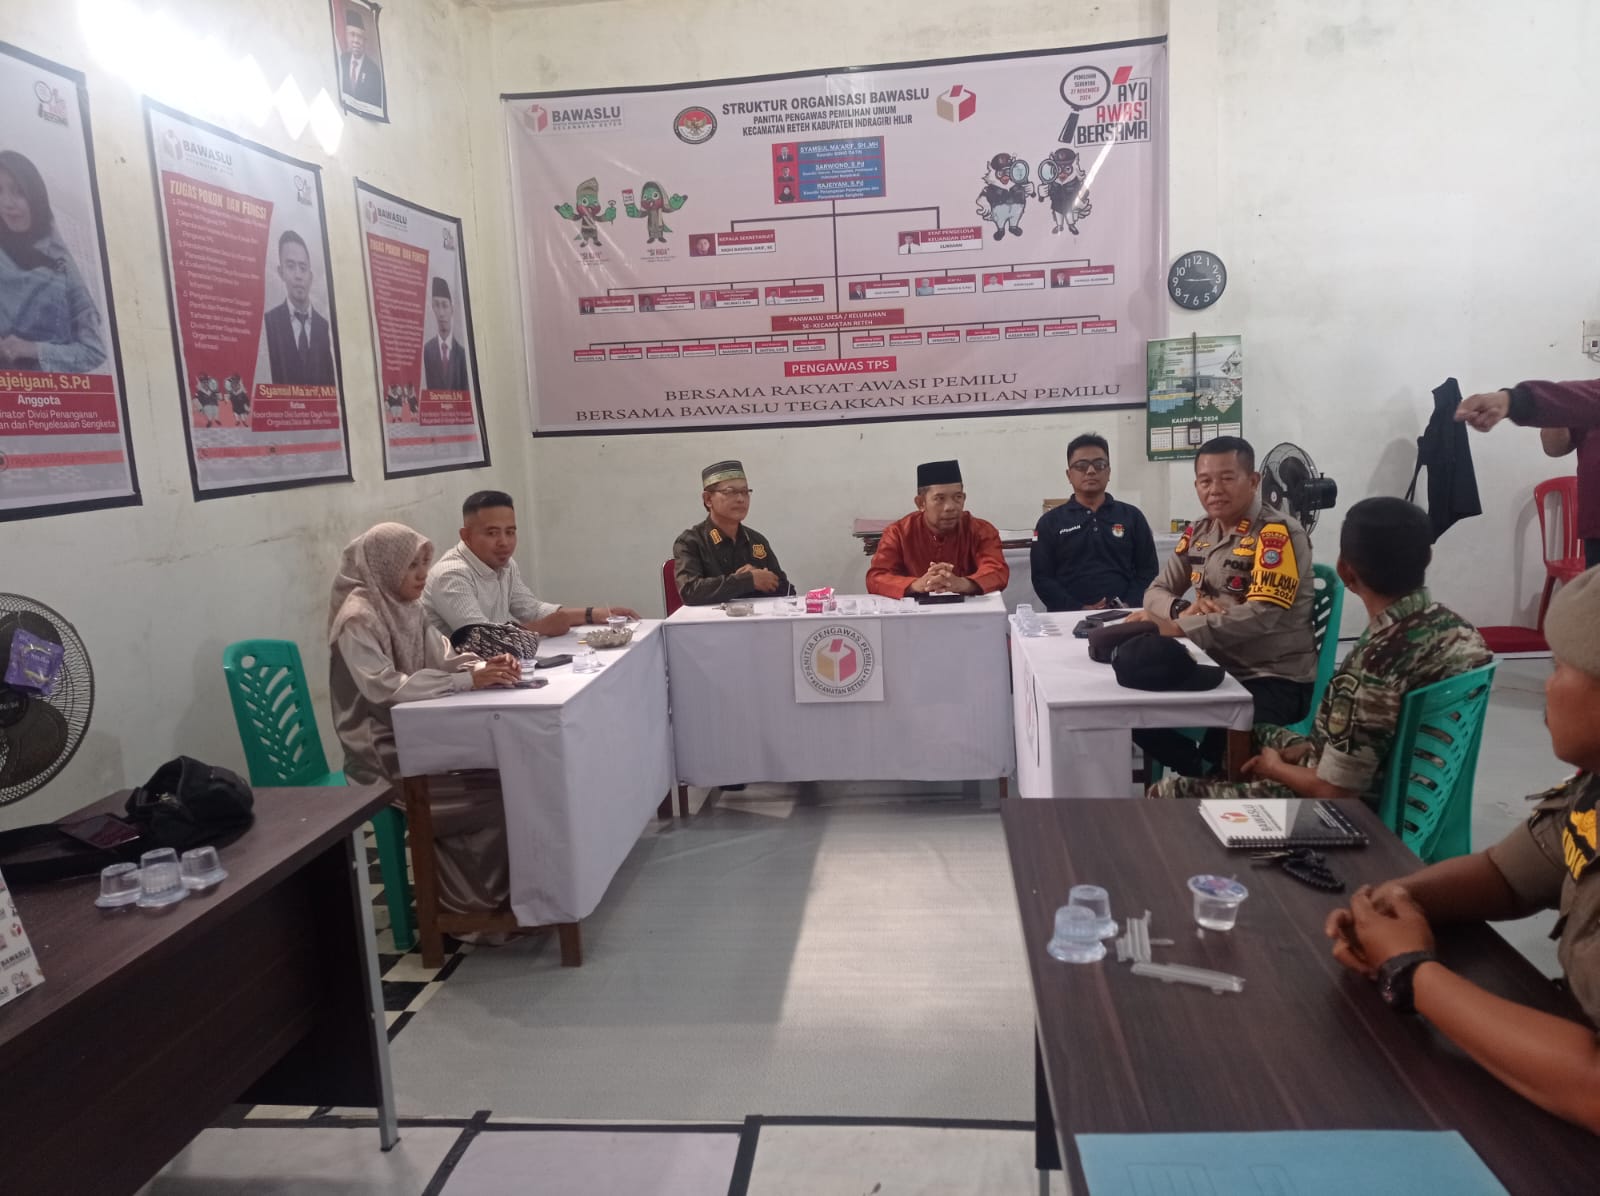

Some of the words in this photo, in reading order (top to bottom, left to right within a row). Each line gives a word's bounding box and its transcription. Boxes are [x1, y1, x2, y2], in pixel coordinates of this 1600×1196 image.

[1118, 81, 1148, 102] AYO
[722, 97, 788, 116] STRUKTUR
[793, 93, 868, 110] ORGANISASI
[870, 87, 930, 104] BAWASLU
[551, 106, 621, 123] BAWASLU
[753, 113, 783, 125] PANITIA
[785, 110, 828, 122] PENGAWAS
[829, 107, 871, 119] PEMILIHAN
[872, 105, 897, 116] UMUM
[1096, 102, 1148, 123] AWASI
[742, 124, 786, 137] KECAMATAN
[786, 122, 810, 134] RETEH
[811, 119, 854, 131] KABUPATEN
[855, 116, 892, 128] INDRAGIRI
[893, 114, 913, 125] HILIR
[1077, 120, 1148, 144] BERSAMA
[182, 139, 233, 166] BAWASLU
[170, 179, 198, 200] TUGAS
[1183, 258, 1191, 269] 11
[1193, 255, 1202, 265] 12
[1206, 256, 1210, 267] 1
[1176, 266, 1186, 277] 10
[1212, 264, 1219, 274] 2
[1172, 276, 1179, 287] 9
[1215, 274, 1221, 284] 3
[1175, 287, 1181, 297] 8
[1211, 285, 1218, 294] 4
[1183, 294, 1190, 304] 7
[1192, 295, 1200, 306] 6
[1203, 292, 1210, 303] 5
[791, 361, 864, 375] PENGAWAS
[866, 359, 890, 370] TPS
[59, 375, 91, 390] S.Pd
[665, 387, 766, 401] BERSAMA
[771, 382, 854, 398] RAKYAT
[856, 377, 928, 392] AWASI
[933, 372, 1018, 389] PEMILU
[18, 394, 61, 408] Anggota
[576, 406, 675, 422] BERSAMA
[679, 402, 779, 418] BAWASLU
[784, 396, 911, 412] TEGAKKAN
[911, 389, 1028, 407] KEADILAN
[1034, 383, 1122, 400] PEMILU
[27, 409, 49, 418] Divisi
[50, 409, 98, 421] Penanganan
[11, 420, 28, 430] dan
[81, 420, 116, 431] Sengketa
[1263, 571, 1298, 594] WILAYAH
[803, 643, 815, 677] PANITIA
[812, 627, 863, 642] PENGAWAS
[860, 641, 873, 676] PEMILU
[811, 678, 847, 695] KECAMATAN
[846, 678, 867, 693] RETEH
